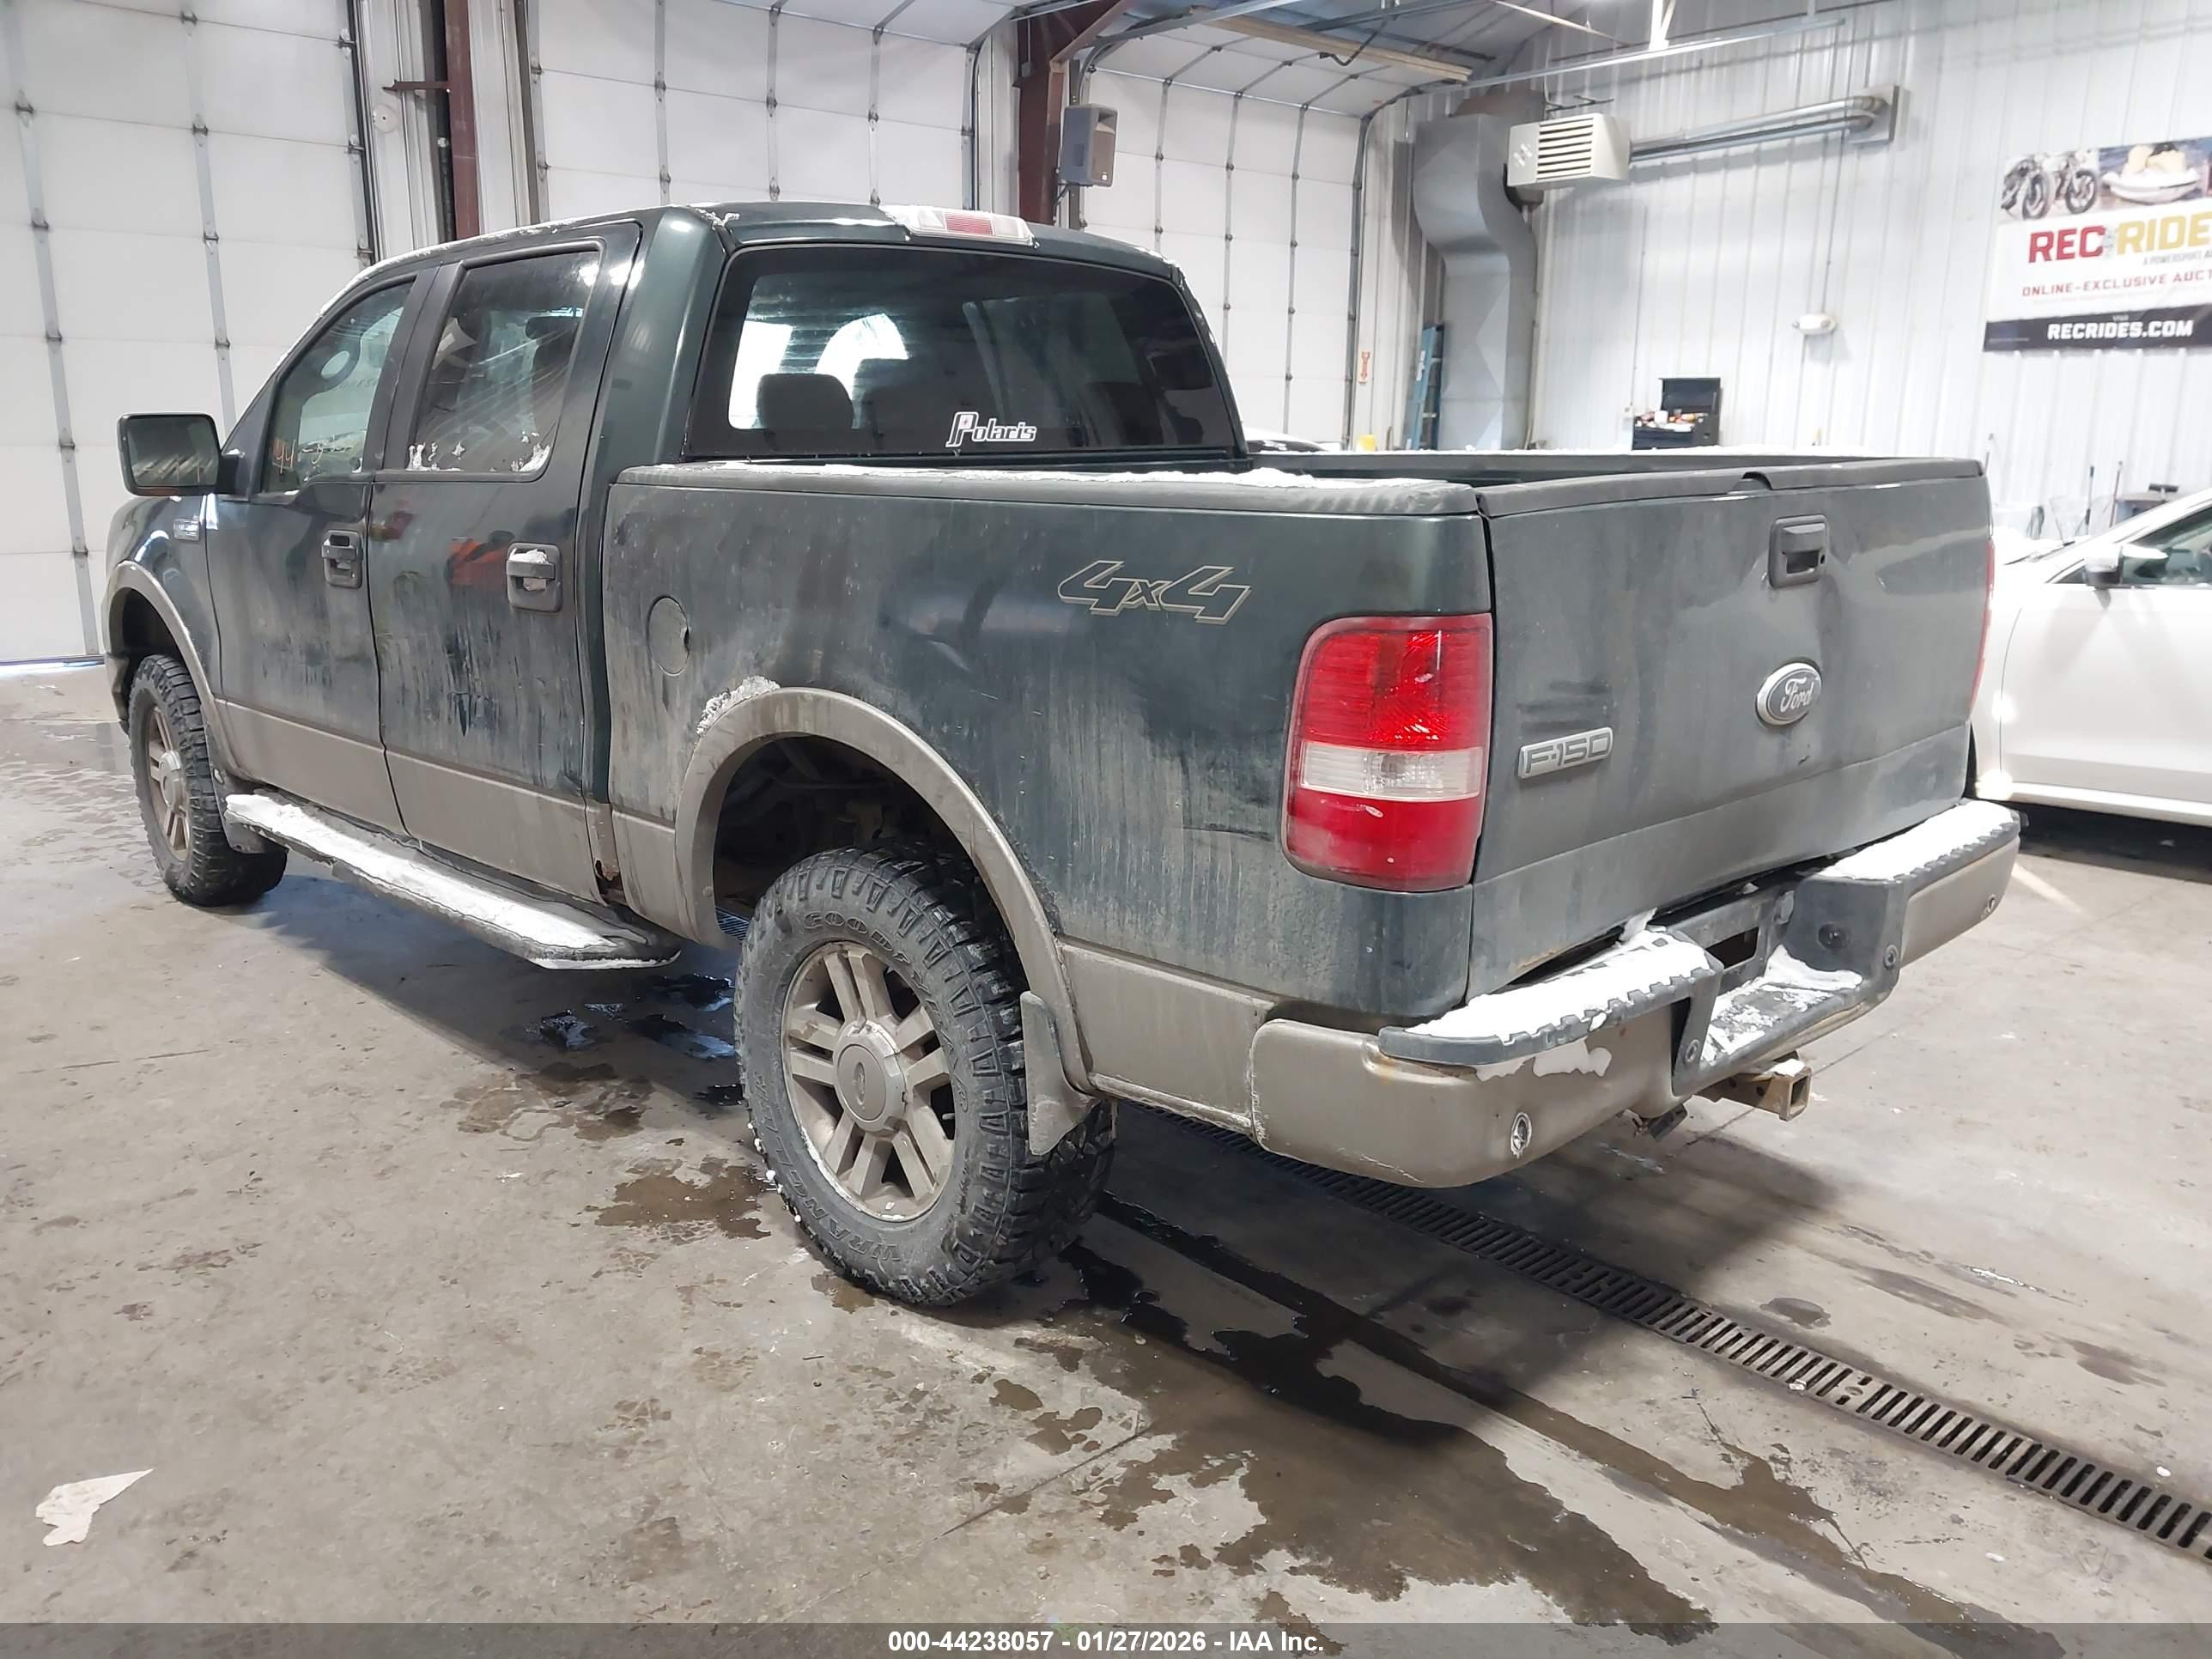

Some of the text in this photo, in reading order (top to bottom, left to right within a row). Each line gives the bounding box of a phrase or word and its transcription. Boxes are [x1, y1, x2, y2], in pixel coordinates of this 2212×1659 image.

[2028, 225, 2106, 263] REC
[2047, 319, 2194, 340] RECRIDES.COM
[945, 411, 1037, 447] Polaris
[1057, 560, 1251, 625] 4x4
[1780, 677, 1814, 713] Ford
[1524, 731, 1612, 775] F-150
